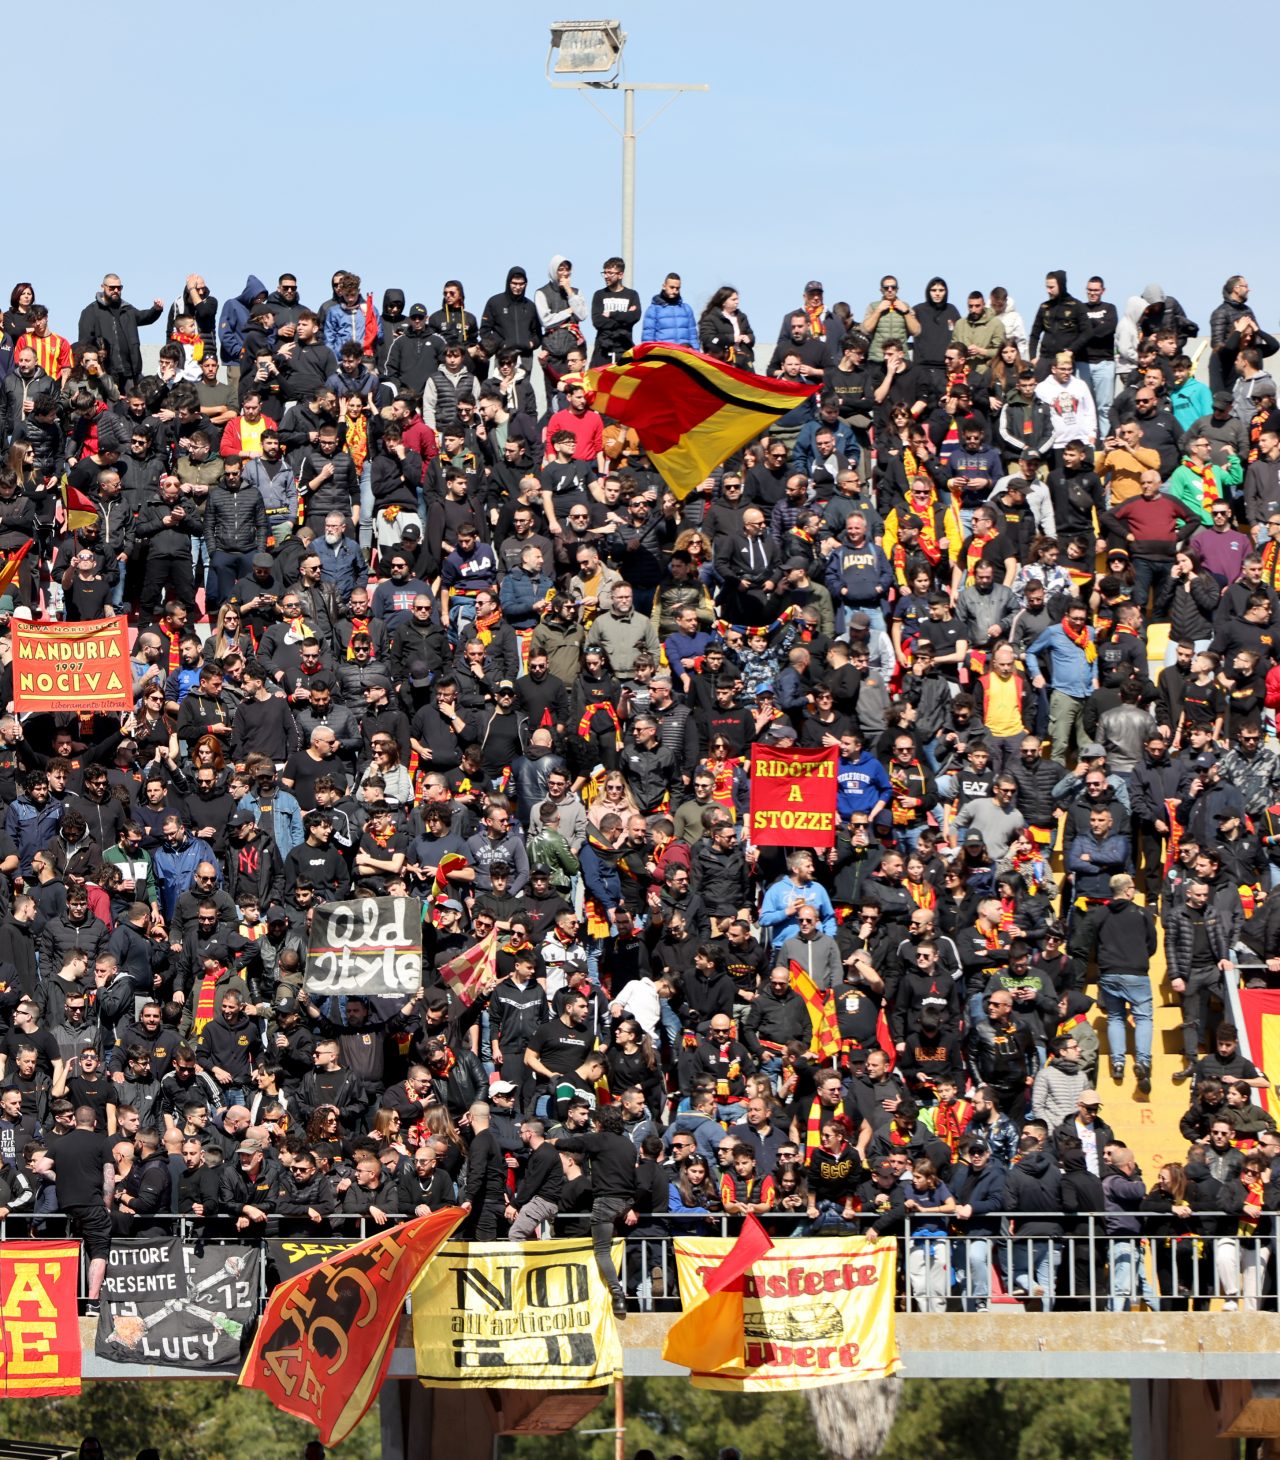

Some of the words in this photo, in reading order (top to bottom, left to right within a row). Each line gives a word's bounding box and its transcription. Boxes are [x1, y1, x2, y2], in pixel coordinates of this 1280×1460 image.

[19, 638, 121, 660] MANDURIA
[55, 662, 84, 672] 1997
[20, 671, 123, 692] NOCIVA
[755, 760, 835, 778] RIDOTTI
[787, 784, 804, 802] A
[962, 781, 988, 793] EA7
[754, 810, 833, 831] STOZZE
[109, 1246, 170, 1267] OTTORE
[281, 1243, 357, 1264] SEN
[448, 1262, 590, 1312] NO
[451, 1308, 592, 1336] all'articolo
[142, 1332, 219, 1361] LUCY
